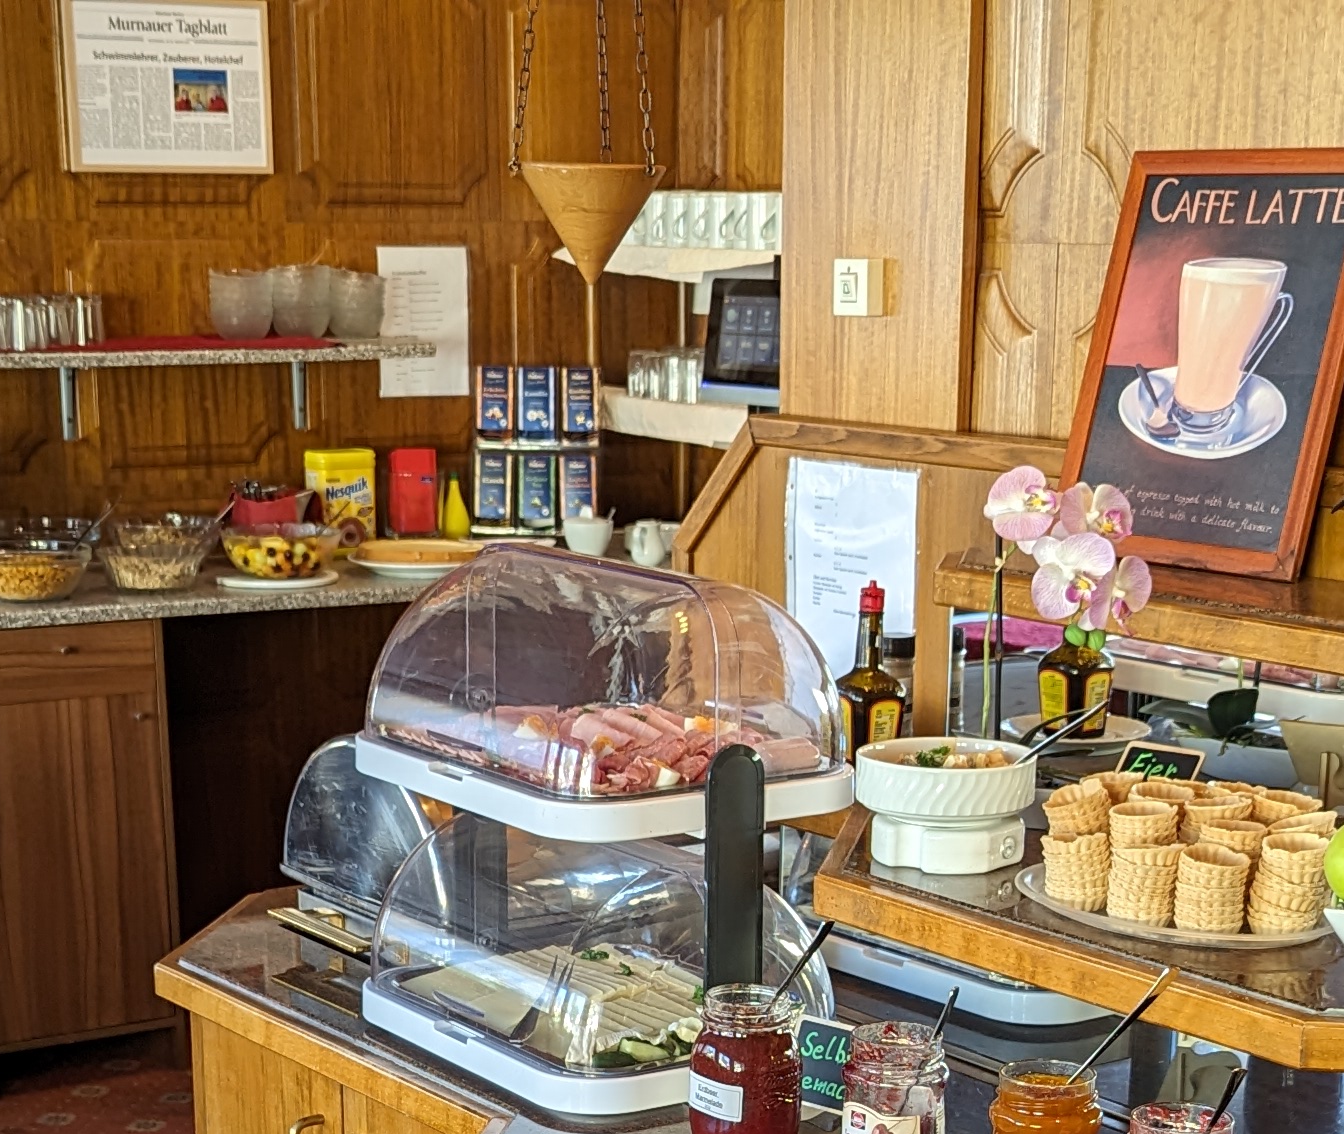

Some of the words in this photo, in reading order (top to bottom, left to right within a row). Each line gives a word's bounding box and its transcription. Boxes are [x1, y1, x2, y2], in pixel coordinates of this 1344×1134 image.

[108, 16, 173, 33] Murnauer
[176, 19, 228, 38] Tagblatt
[1149, 177, 1239, 225] CAFFE
[325, 477, 369, 501] Nesquik
[1137, 490, 1171, 503] espresso
[1174, 494, 1200, 506] topped
[1205, 495, 1223, 508] with
[1226, 498, 1240, 509] hot
[1245, 500, 1265, 513] milk
[1270, 505, 1280, 514] to
[1140, 506, 1165, 519] drink
[1169, 509, 1186, 520] with
[1191, 514, 1197, 523] a
[1201, 514, 1236, 529] delicate
[1128, 752, 1178, 778] Eier
[800, 1031, 852, 1065] Selb
